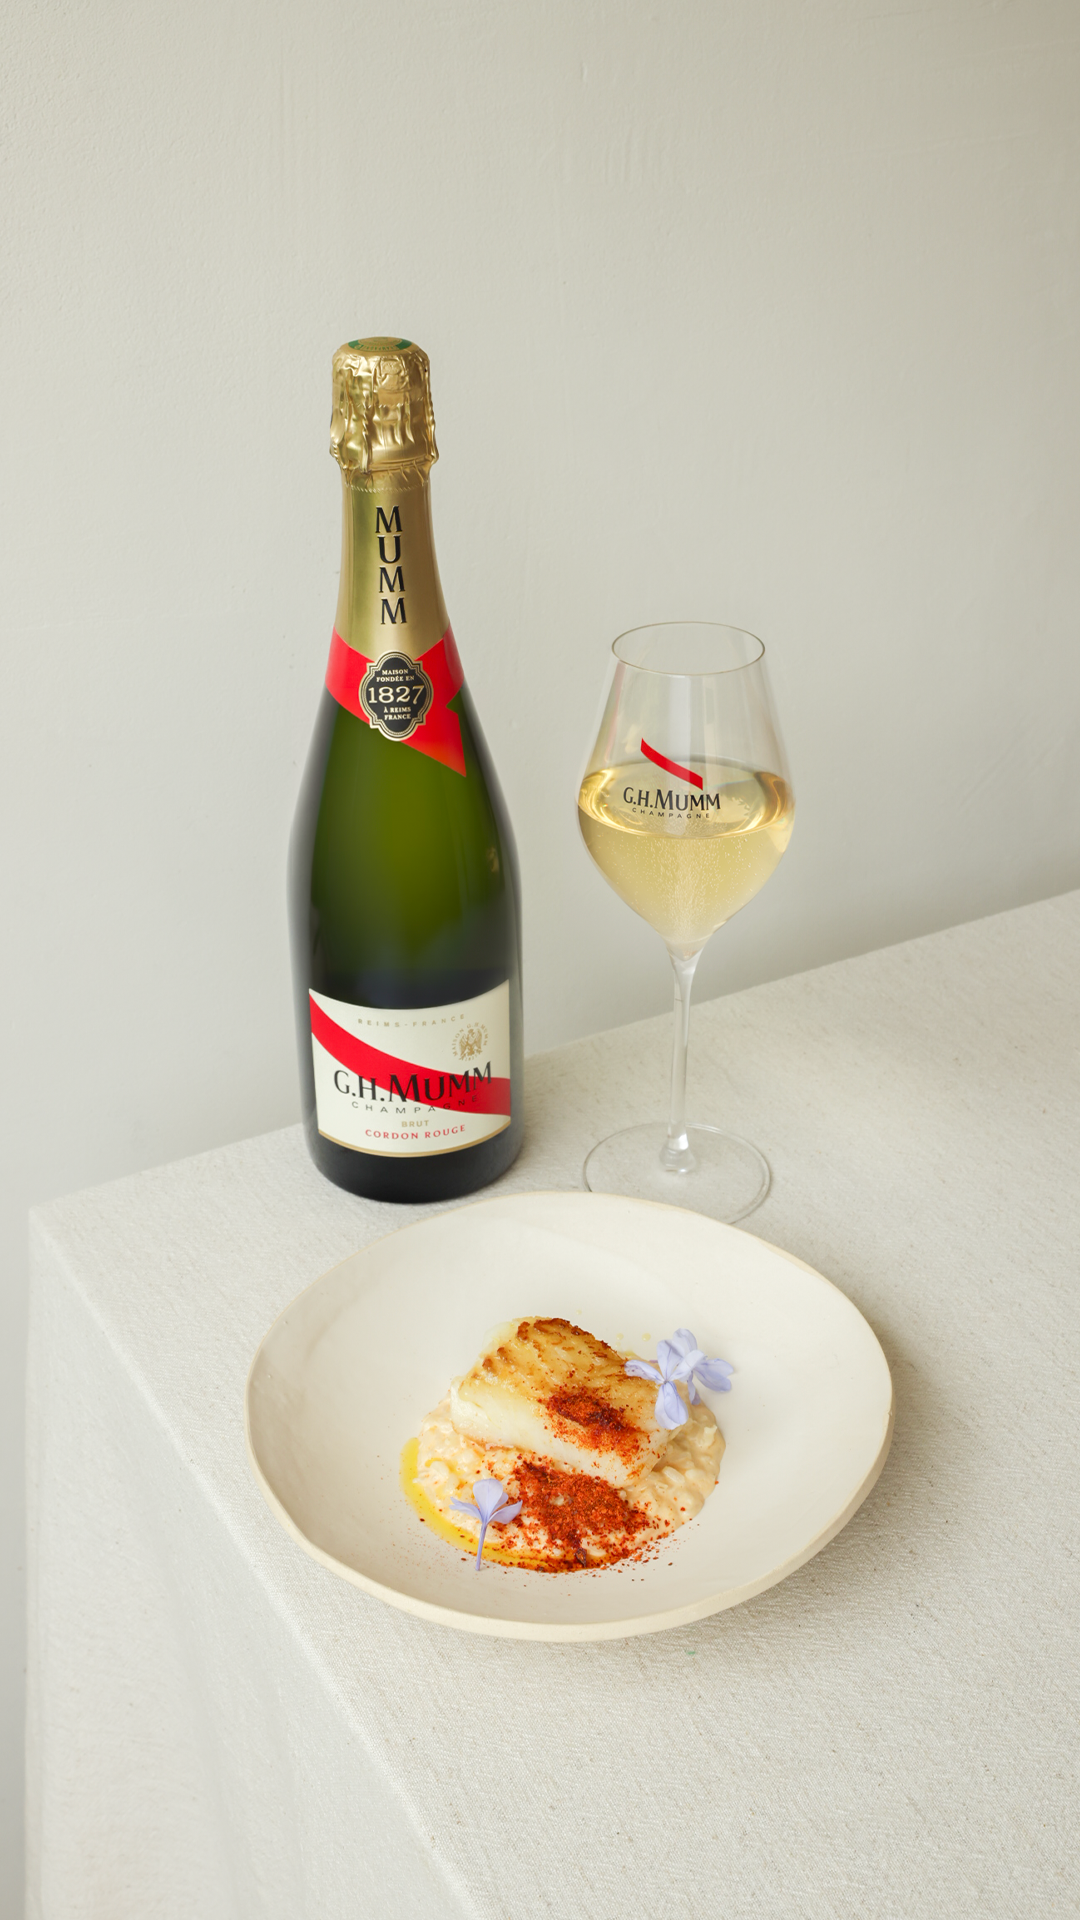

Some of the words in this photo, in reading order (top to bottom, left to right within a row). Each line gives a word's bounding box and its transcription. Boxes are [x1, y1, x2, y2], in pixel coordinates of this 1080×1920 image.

[375, 506, 407, 624] MUMM
[368, 685, 424, 704] 1827
[632, 808, 710, 818] CHAMPAGNE
[352, 1095, 477, 1114] CHAMPAGNE
[365, 1129, 418, 1140] CORDON
[424, 1124, 466, 1138] ROUGE
